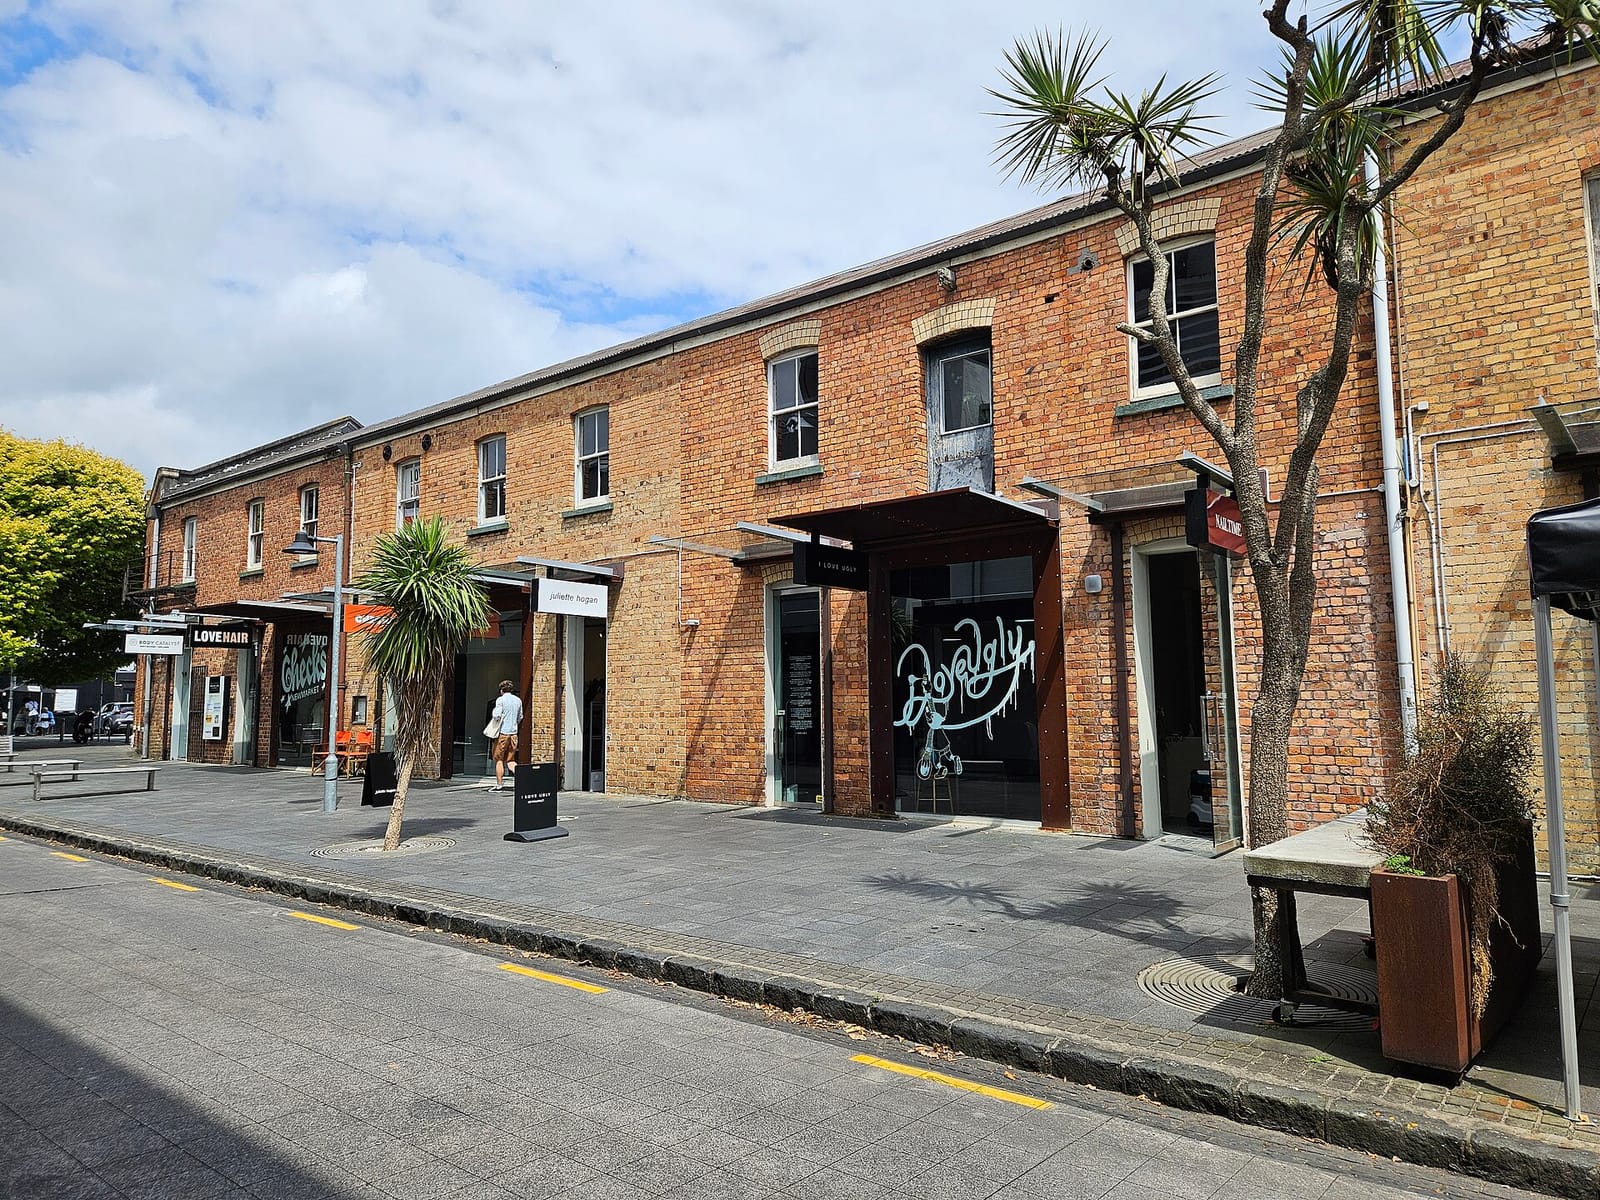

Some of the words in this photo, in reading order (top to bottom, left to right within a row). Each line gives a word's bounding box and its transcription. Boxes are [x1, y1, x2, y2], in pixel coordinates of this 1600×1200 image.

[823, 562, 839, 570] LOVE
[841, 565, 856, 573] UGLY
[549, 591, 575, 602] juliette
[576, 595, 599, 605] hogan
